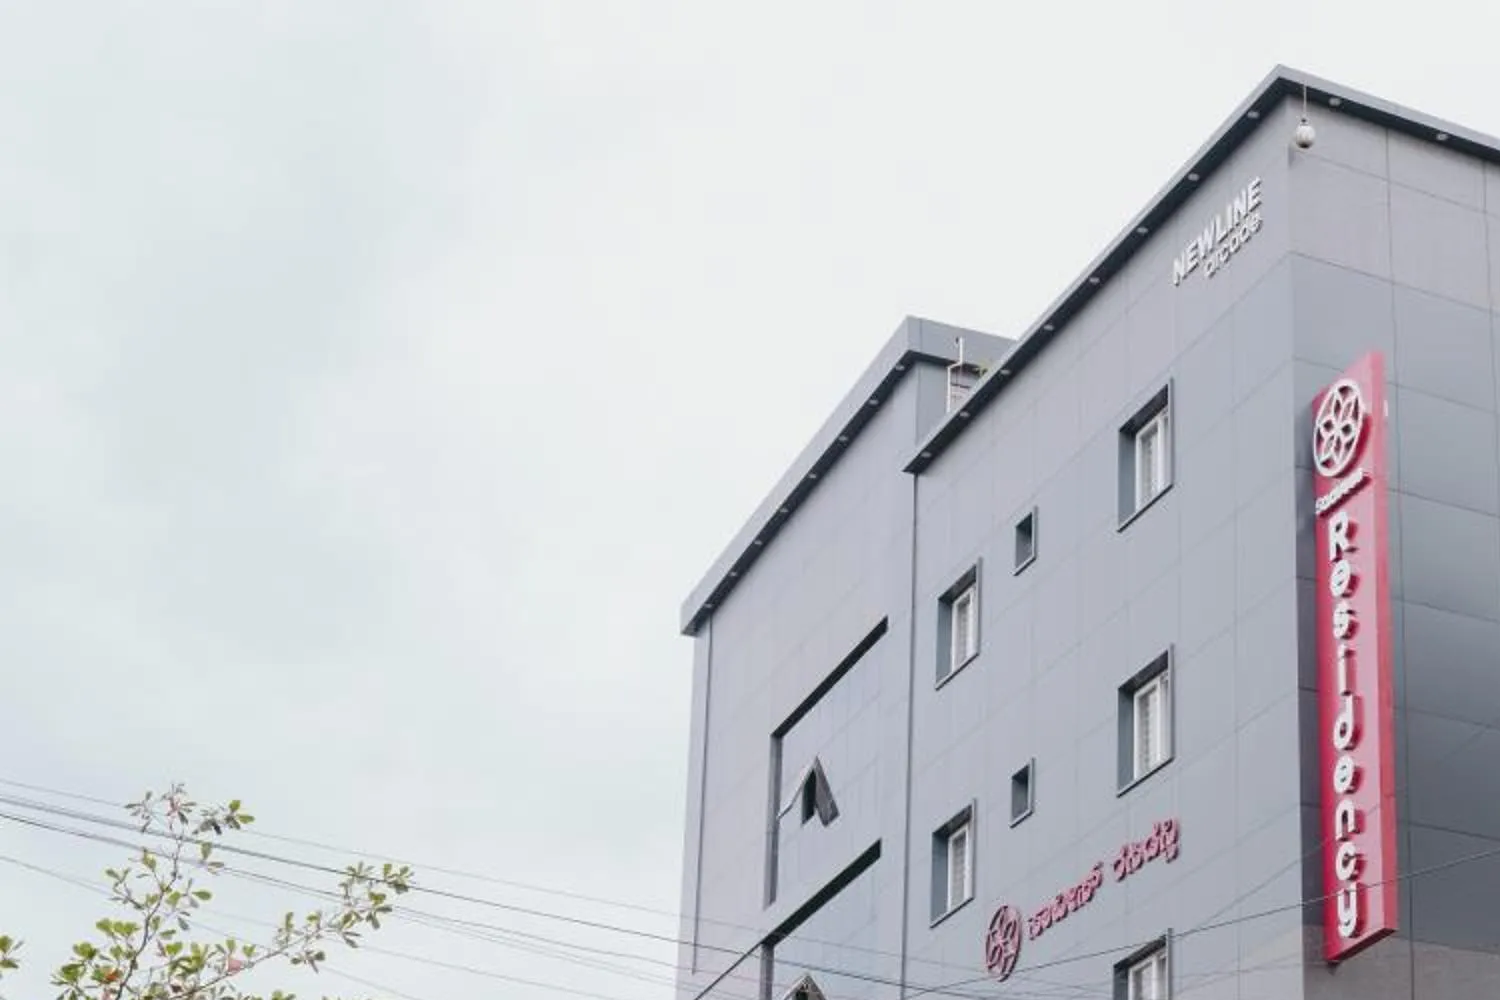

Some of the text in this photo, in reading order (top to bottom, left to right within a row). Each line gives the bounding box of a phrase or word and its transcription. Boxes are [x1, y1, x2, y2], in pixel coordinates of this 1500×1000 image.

[1172, 176, 1262, 286] NEWLINE
[1202, 212, 1263, 278] arcade
[1328, 510, 1358, 937] Residency
